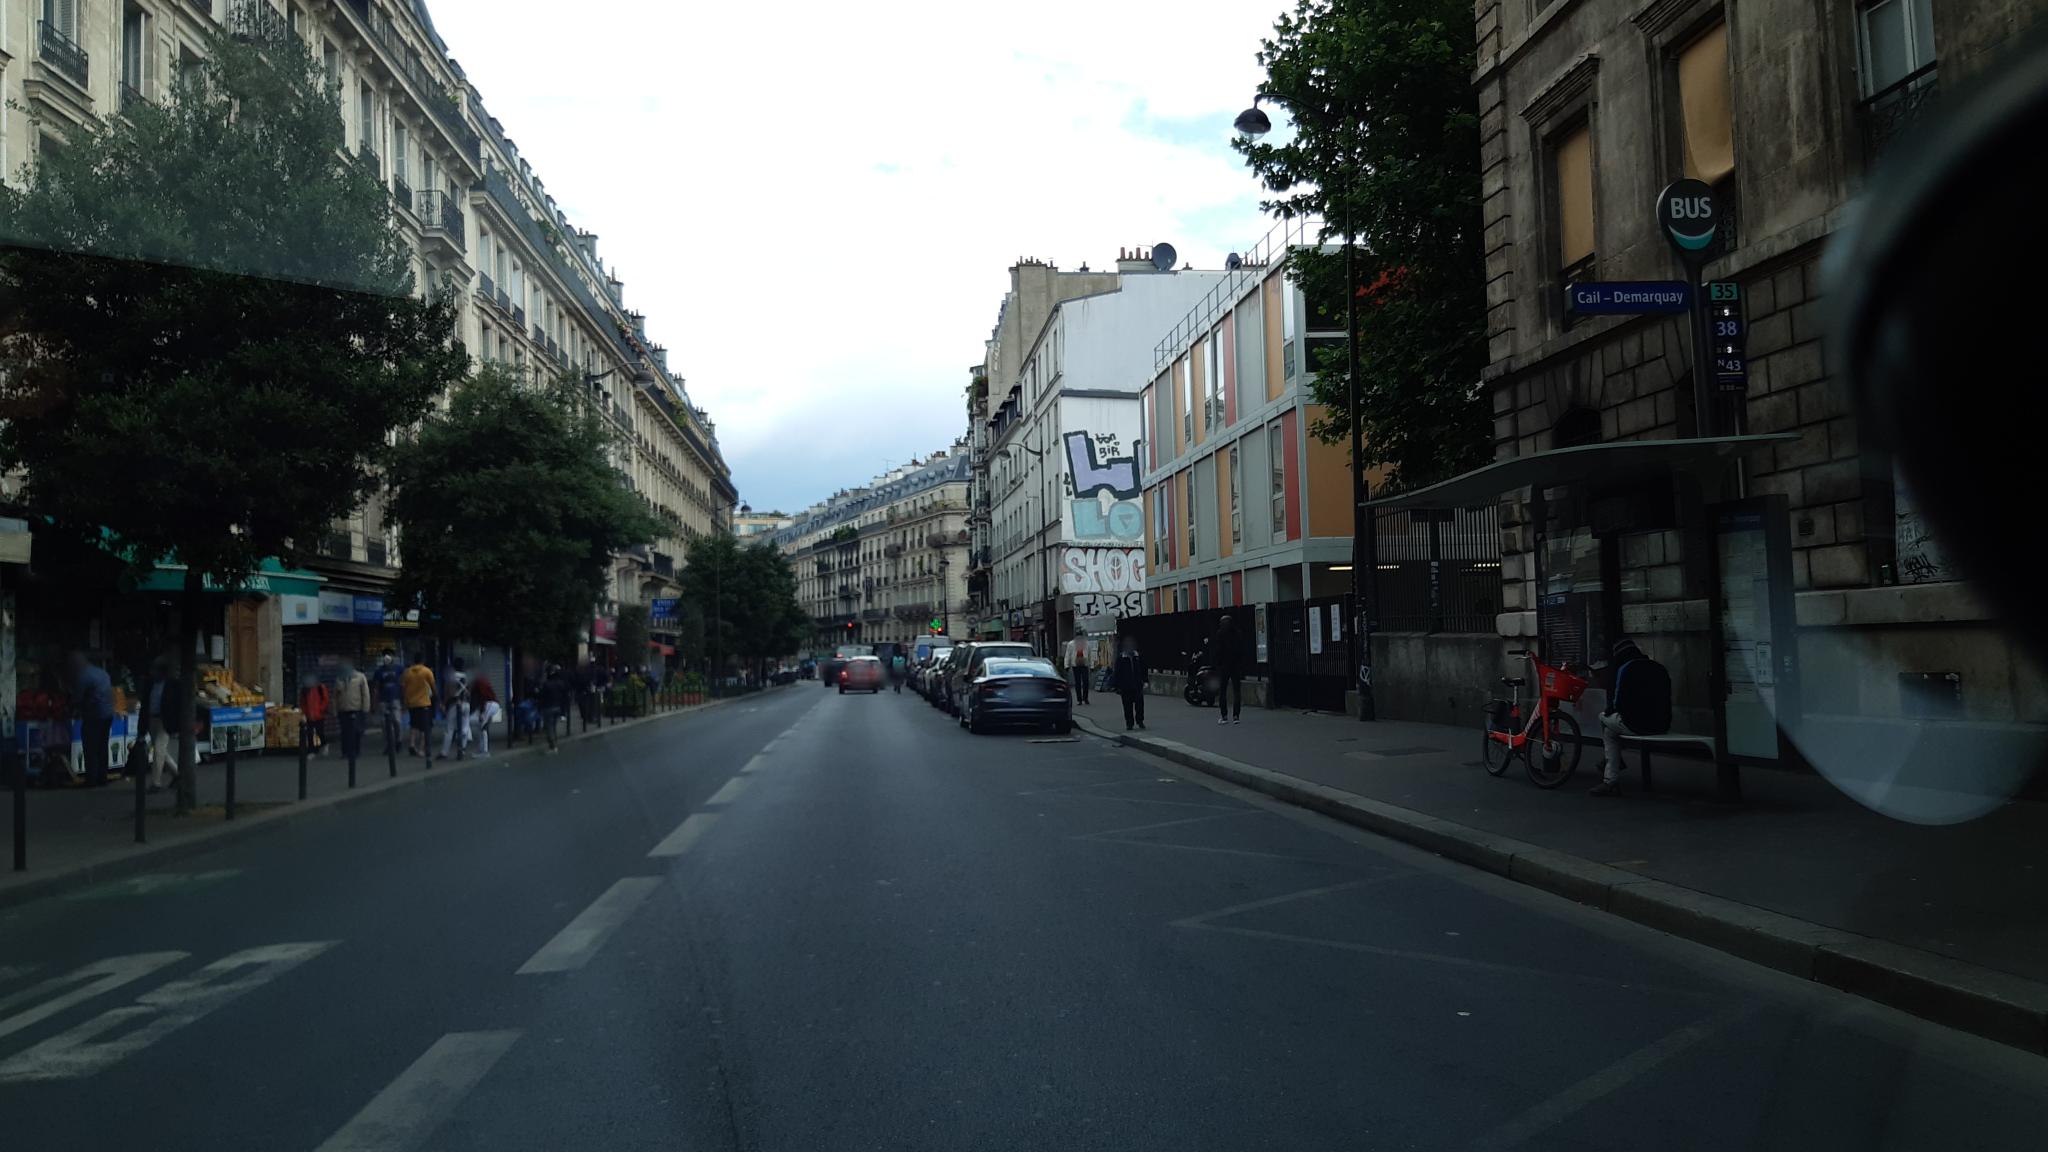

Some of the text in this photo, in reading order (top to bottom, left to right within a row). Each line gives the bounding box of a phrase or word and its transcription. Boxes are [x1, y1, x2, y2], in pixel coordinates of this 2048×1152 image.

[1670, 196, 1712, 219] BUS
[1714, 284, 1734, 299] 35
[1716, 321, 1737, 336] 38
